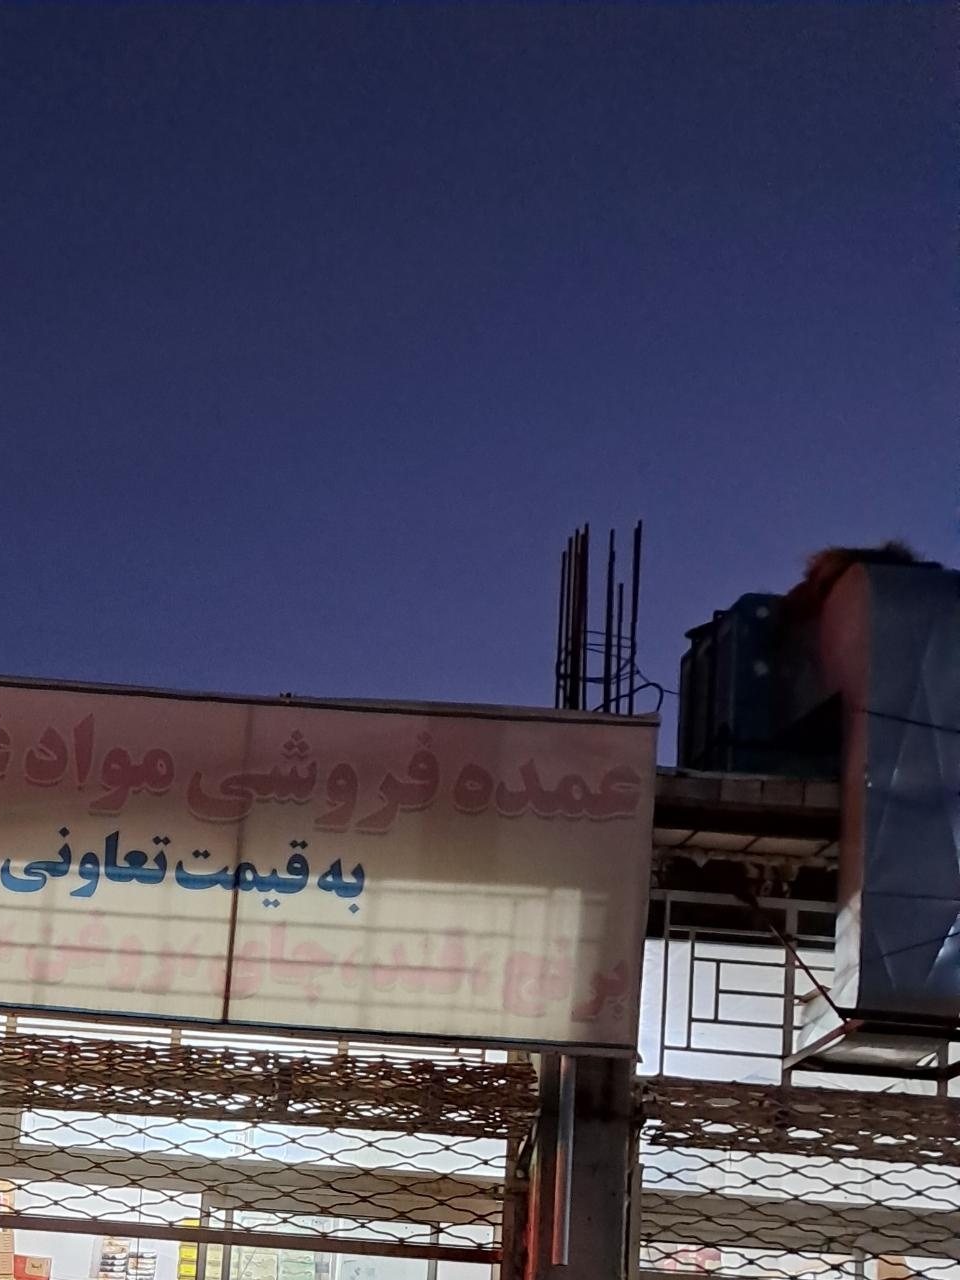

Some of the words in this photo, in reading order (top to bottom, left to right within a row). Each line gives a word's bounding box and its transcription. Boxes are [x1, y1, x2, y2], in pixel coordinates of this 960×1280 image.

[24, 712, 175, 817] مواد
[186, 729, 441, 834] فروشی
[454, 757, 641, 819] عمده
[0, 827, 172, 898] تعاونی
[174, 839, 310, 908] قیمت
[316, 857, 366, 914] به
